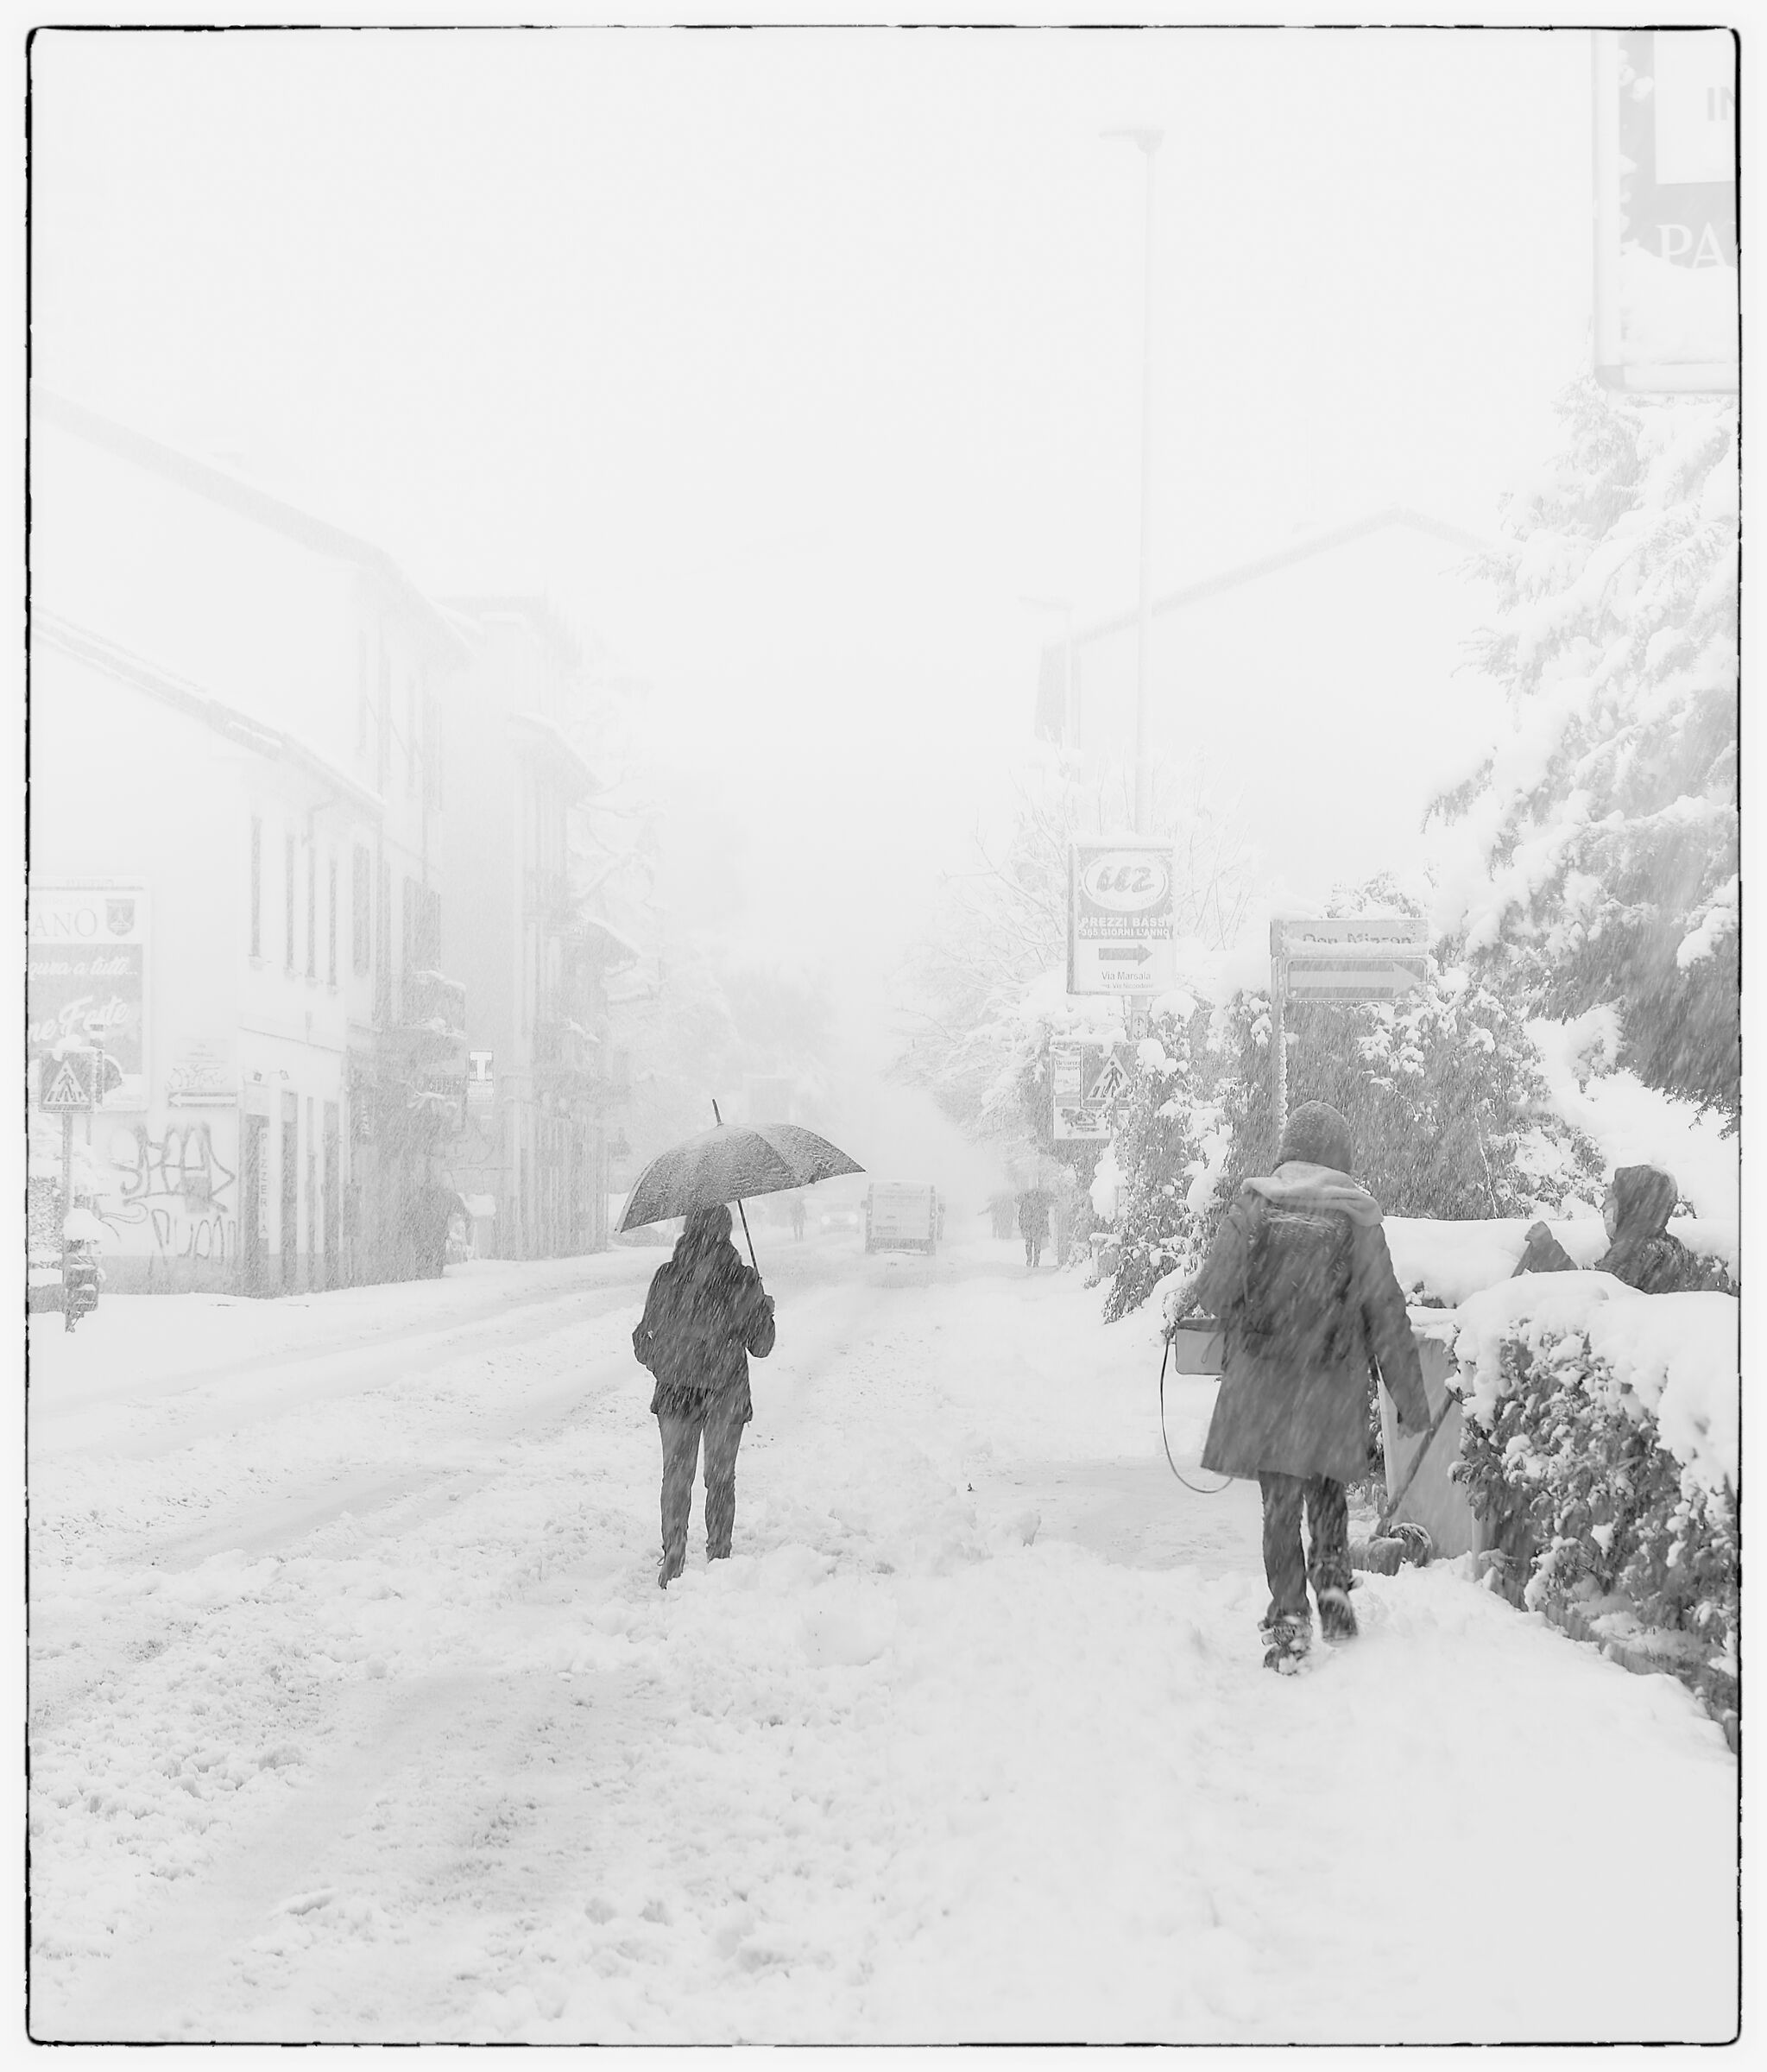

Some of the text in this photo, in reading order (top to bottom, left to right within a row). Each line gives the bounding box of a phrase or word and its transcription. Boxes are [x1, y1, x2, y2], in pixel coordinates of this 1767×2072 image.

[1082, 916, 1128, 927] PREZZI
[1101, 927, 1133, 937] GIORNI
[1137, 927, 1170, 937] L'ANNO
[1101, 970, 1151, 980] Via Marsala
[260, 1132, 268, 1234] PIZZERIA
